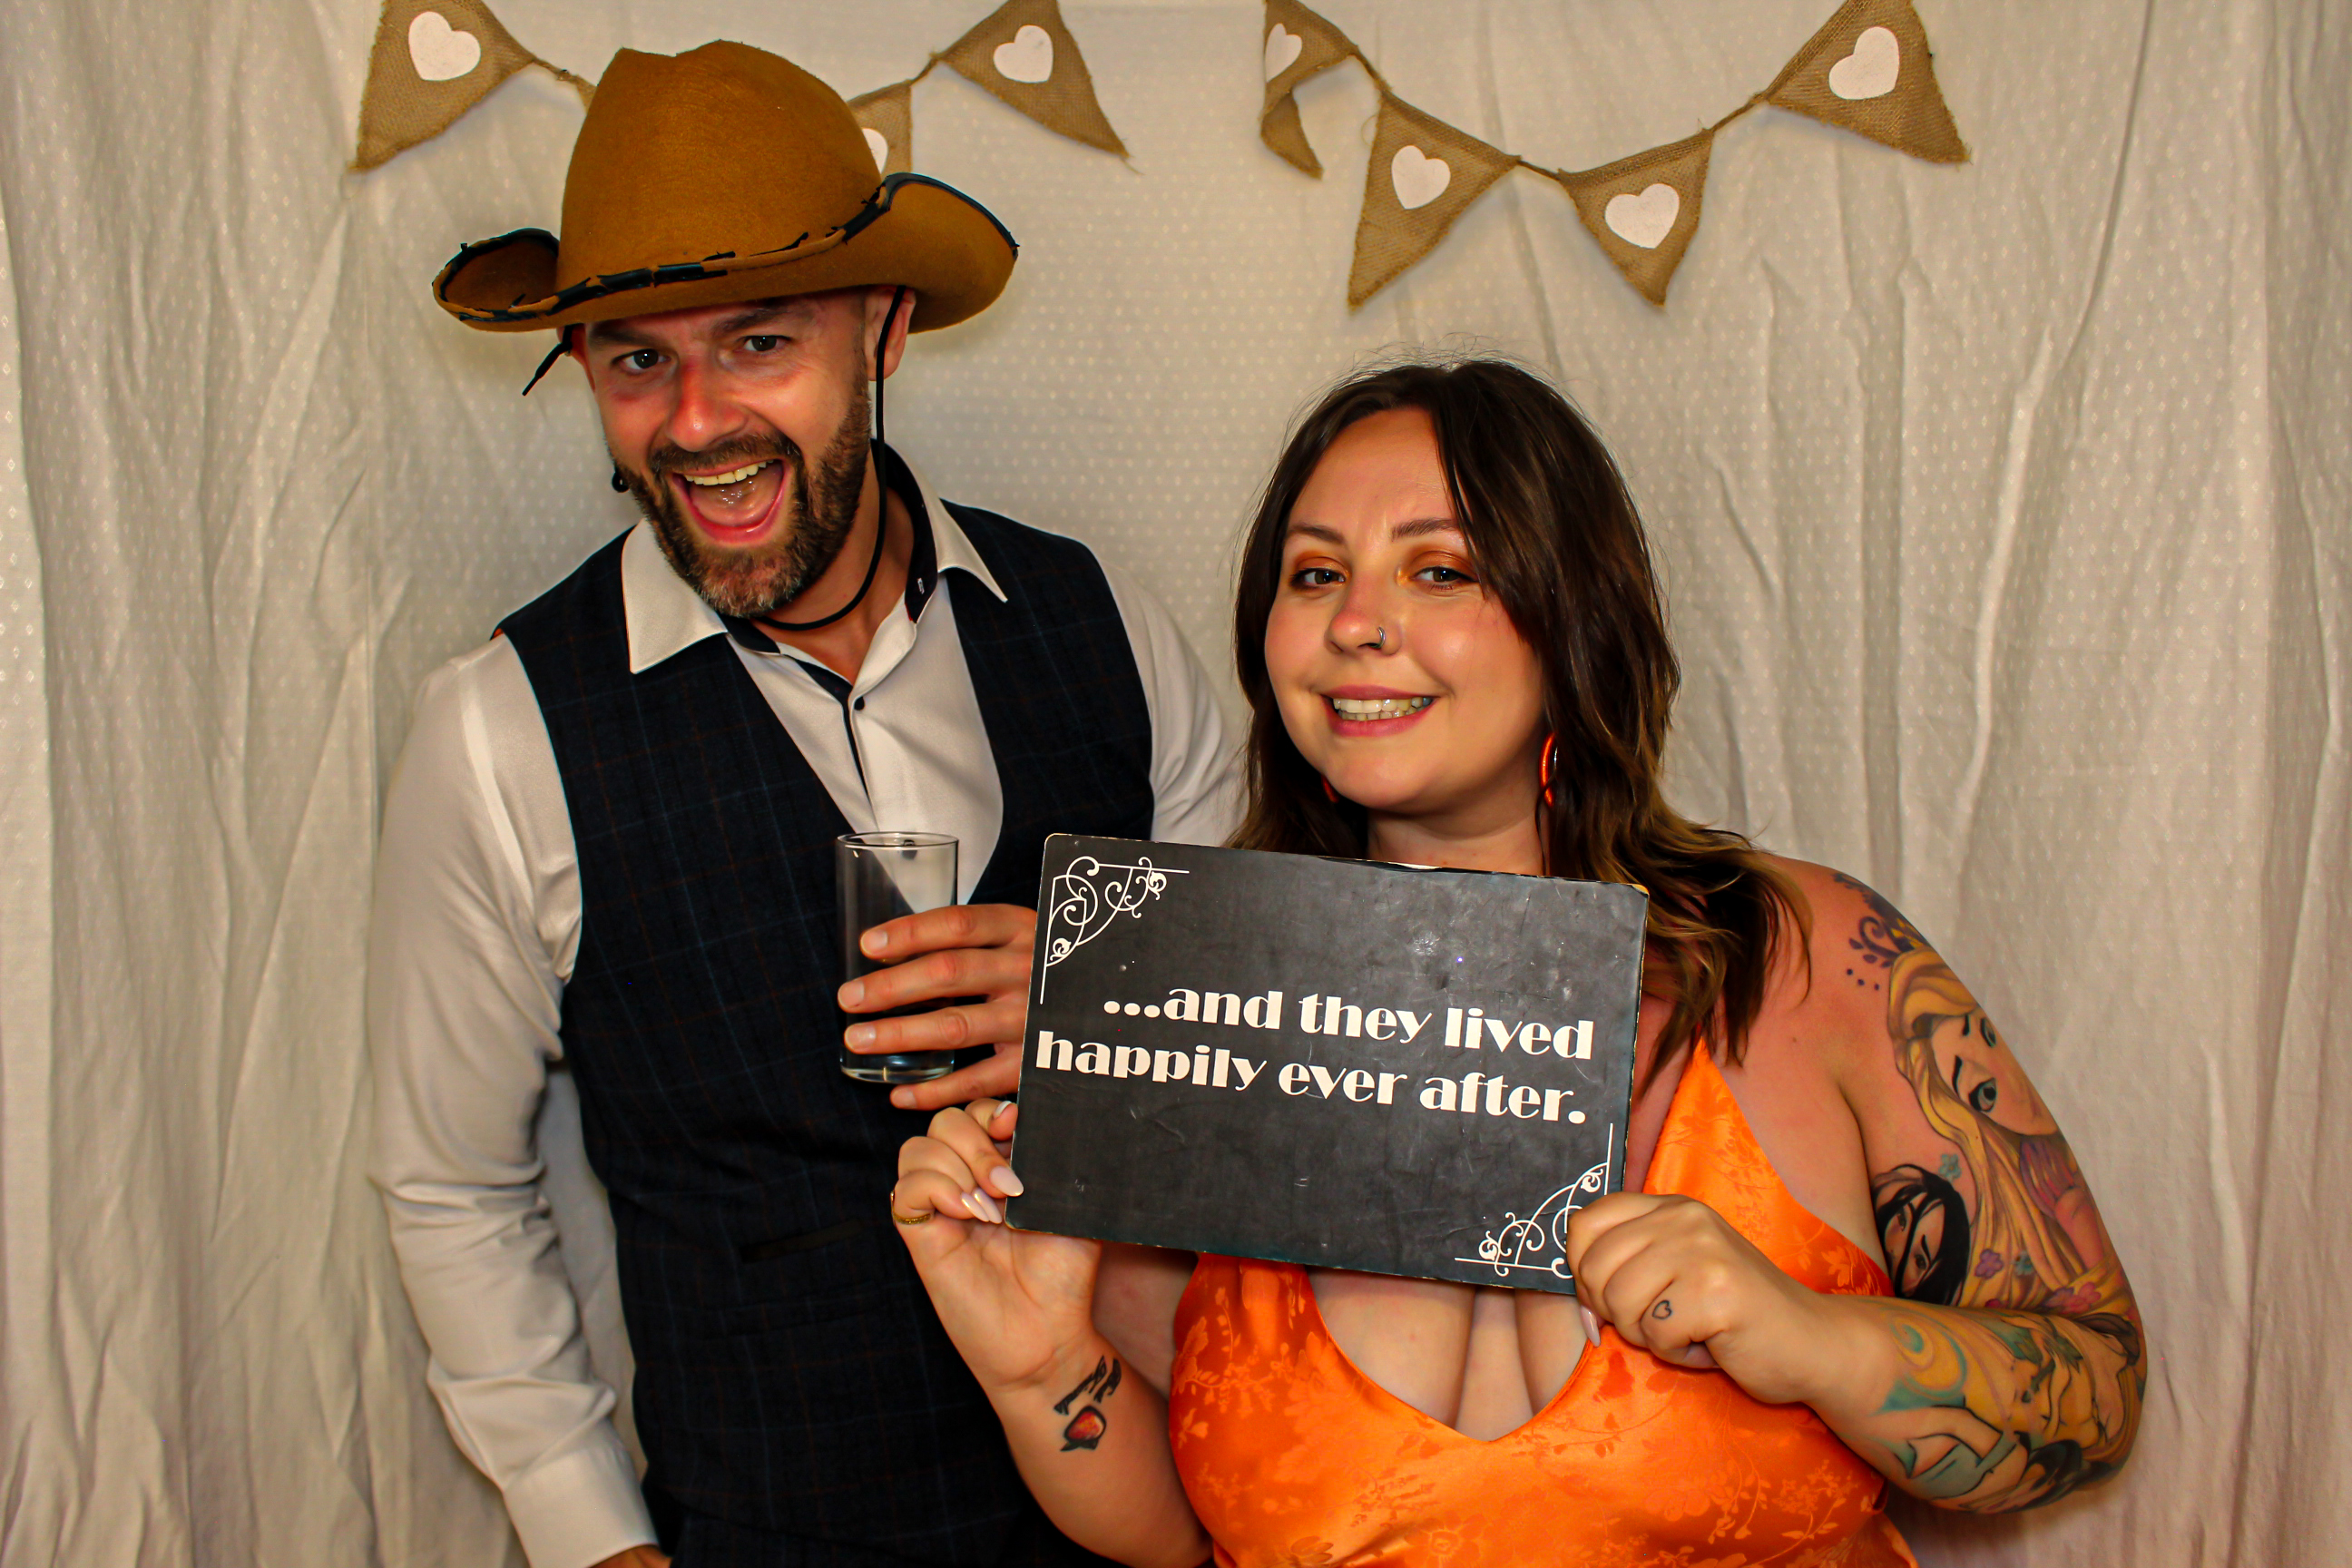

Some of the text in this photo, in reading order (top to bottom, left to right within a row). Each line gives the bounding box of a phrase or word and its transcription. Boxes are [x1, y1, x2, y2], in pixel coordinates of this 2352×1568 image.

[1103, 988, 1594, 1060] ...and they lived
[1035, 1030, 1586, 1124] happily ever after.
